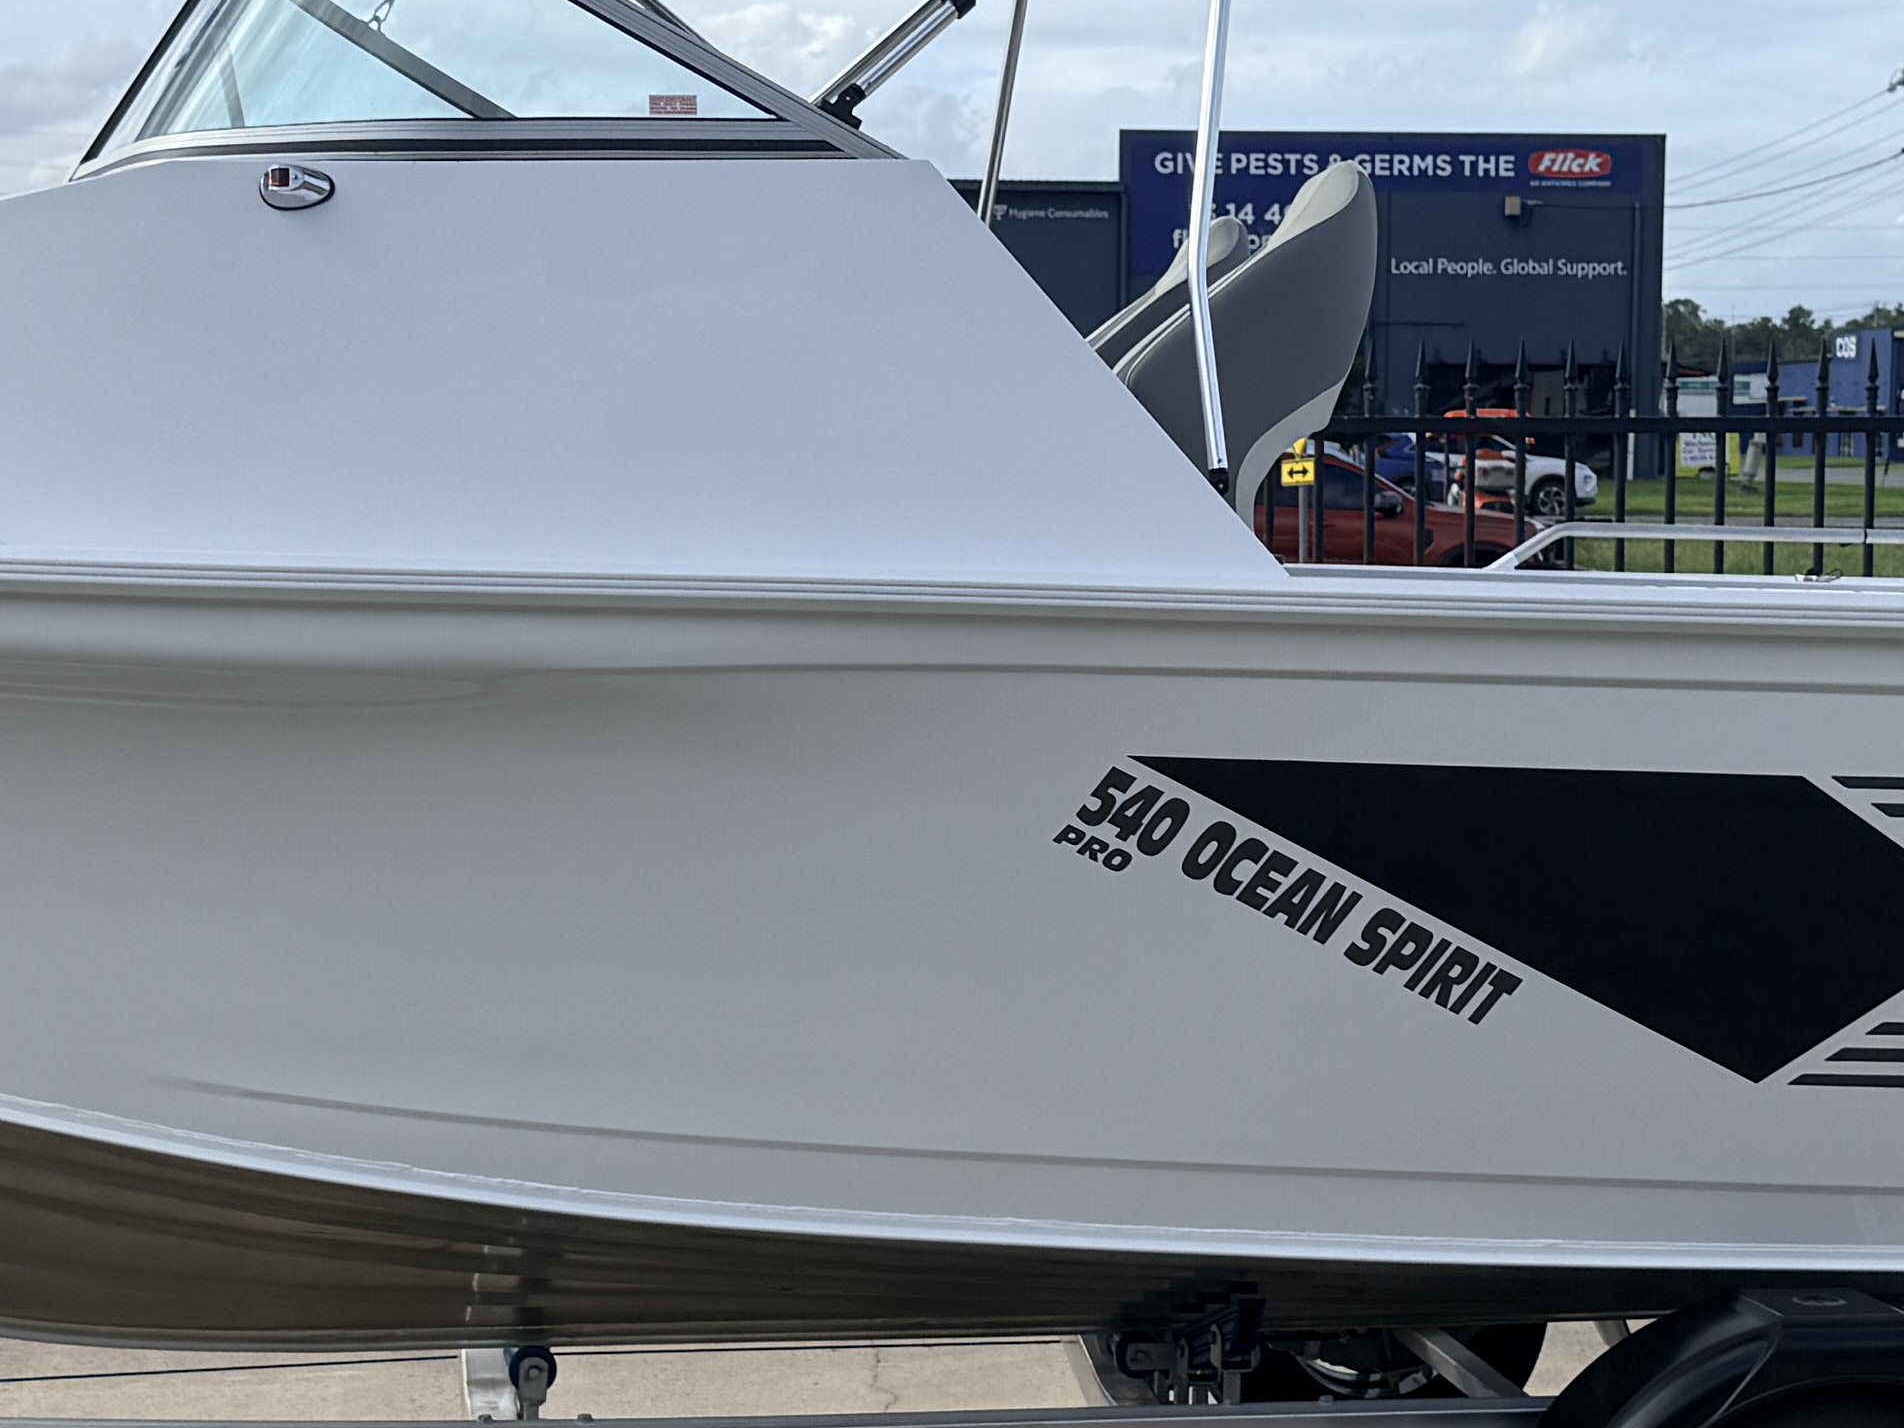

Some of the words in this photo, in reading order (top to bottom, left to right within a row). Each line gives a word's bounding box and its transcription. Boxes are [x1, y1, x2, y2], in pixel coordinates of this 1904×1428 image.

[1230, 153, 1319, 176] PESTS
[1352, 154, 1452, 177] GERMS
[1458, 155, 1516, 177] THE
[1537, 150, 1603, 174] Flick
[1390, 258, 1434, 275] Local
[1436, 258, 1497, 278] People.
[1499, 258, 1553, 276] Global
[1557, 258, 1628, 279] Support.
[1052, 824, 1133, 872] PRO
[1075, 765, 1191, 857] 540
[1181, 820, 1363, 945] OCEAN
[1343, 907, 1524, 1025] SPIRIT
